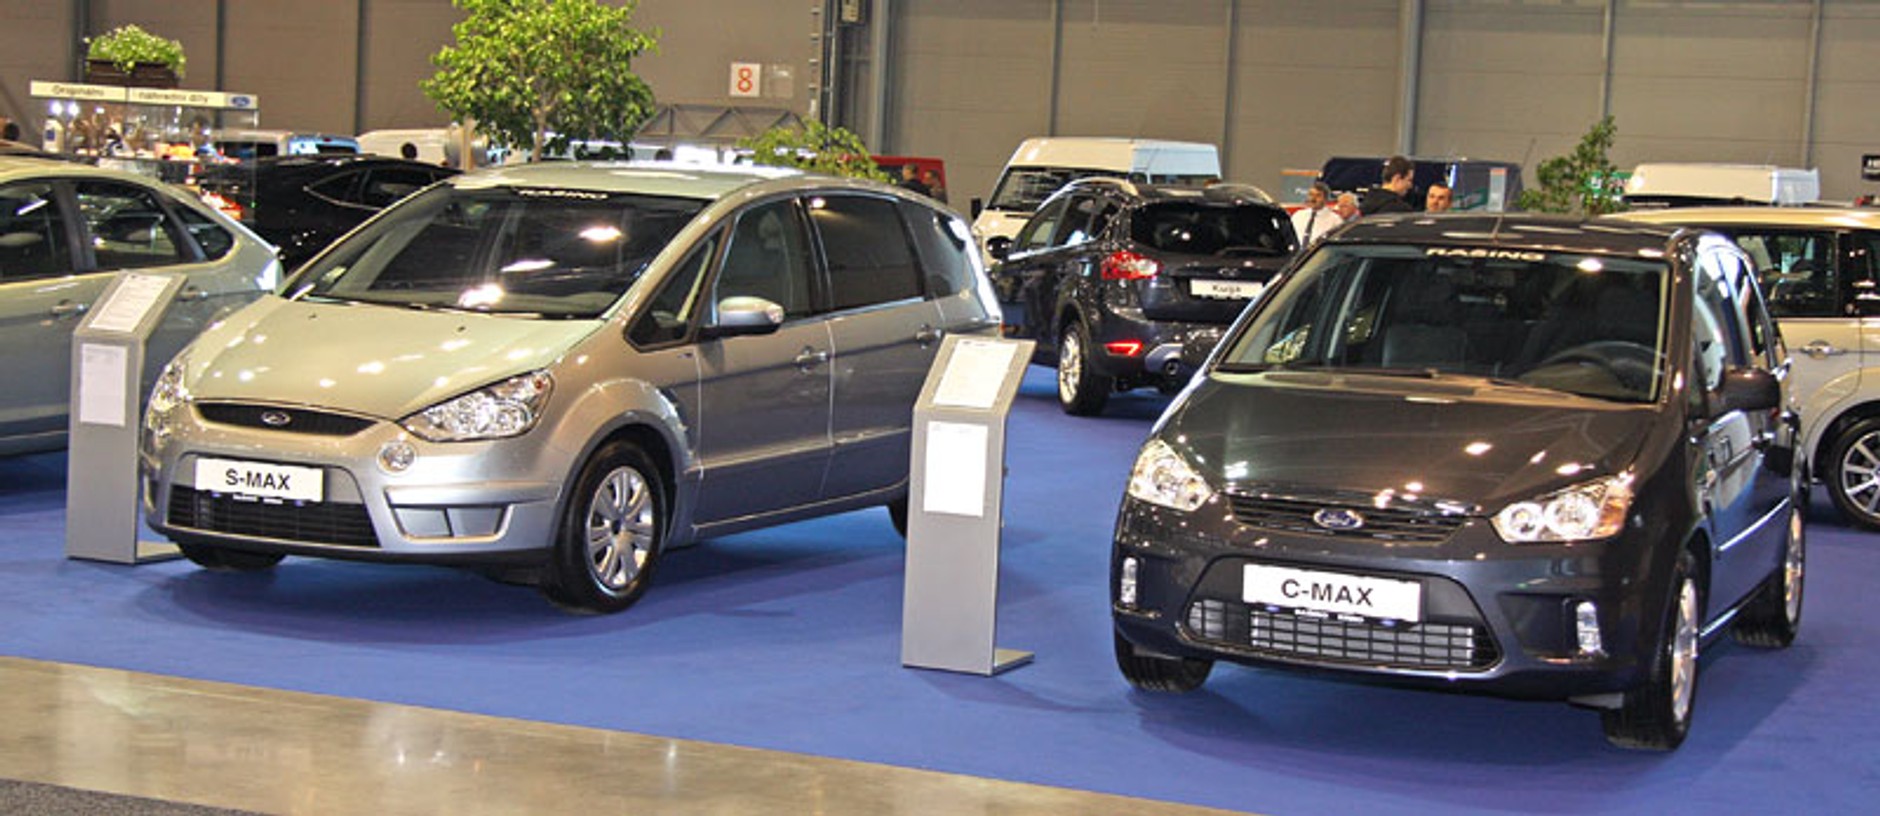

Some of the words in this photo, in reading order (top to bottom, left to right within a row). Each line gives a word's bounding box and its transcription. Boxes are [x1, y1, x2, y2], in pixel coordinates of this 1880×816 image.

[737, 66, 753, 93] 8
[1426, 248, 1545, 261] RASING
[1212, 285, 1242, 295] Kuga
[225, 468, 291, 490] S-MAX
[1281, 578, 1374, 607] C-MAX
